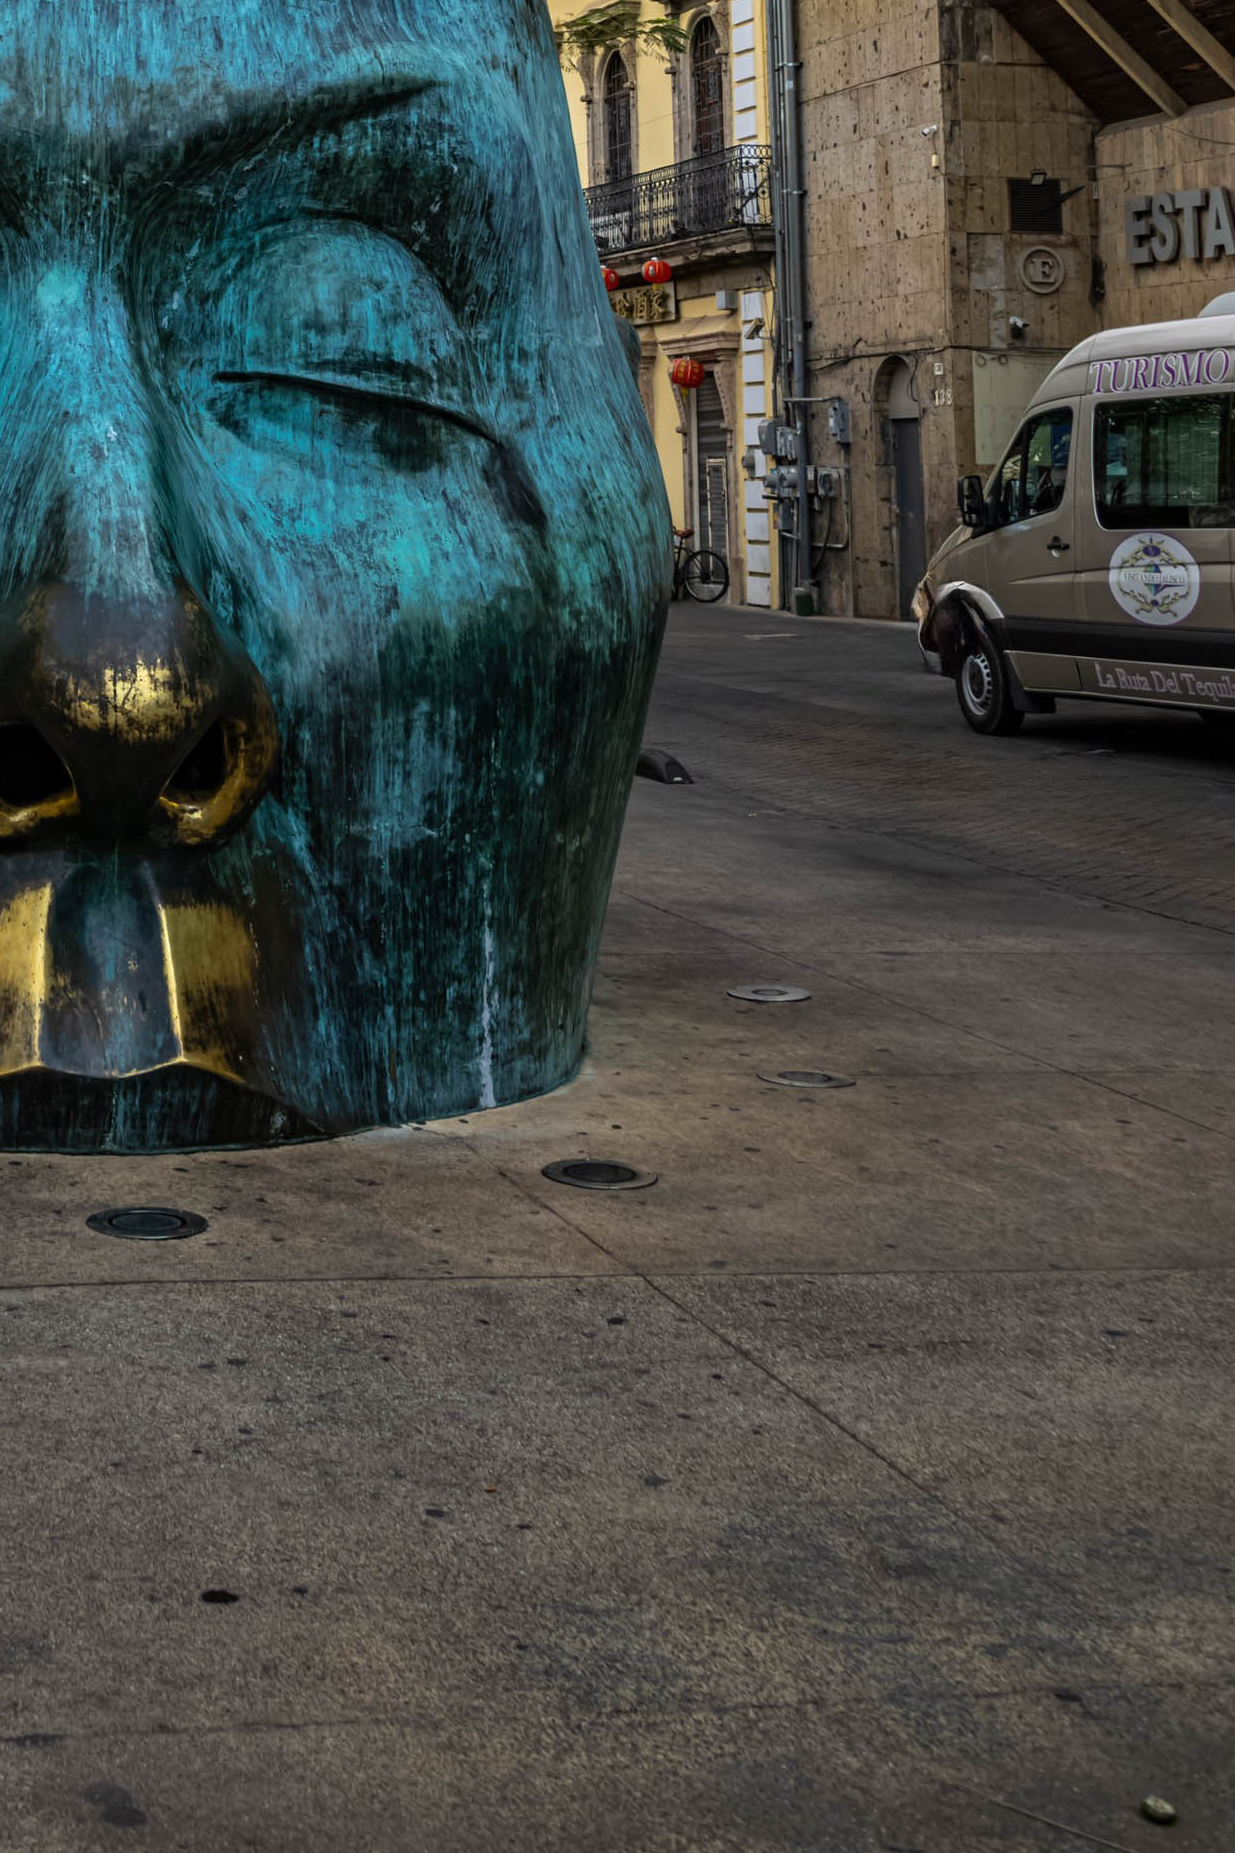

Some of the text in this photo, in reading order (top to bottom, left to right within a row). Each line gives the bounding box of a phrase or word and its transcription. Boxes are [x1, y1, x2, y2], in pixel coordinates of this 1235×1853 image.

[1089, 348, 1230, 394] TURISMO
[1094, 661, 1117, 688] La
[1115, 667, 1152, 691] Ruta
[1150, 670, 1182, 694] Del
